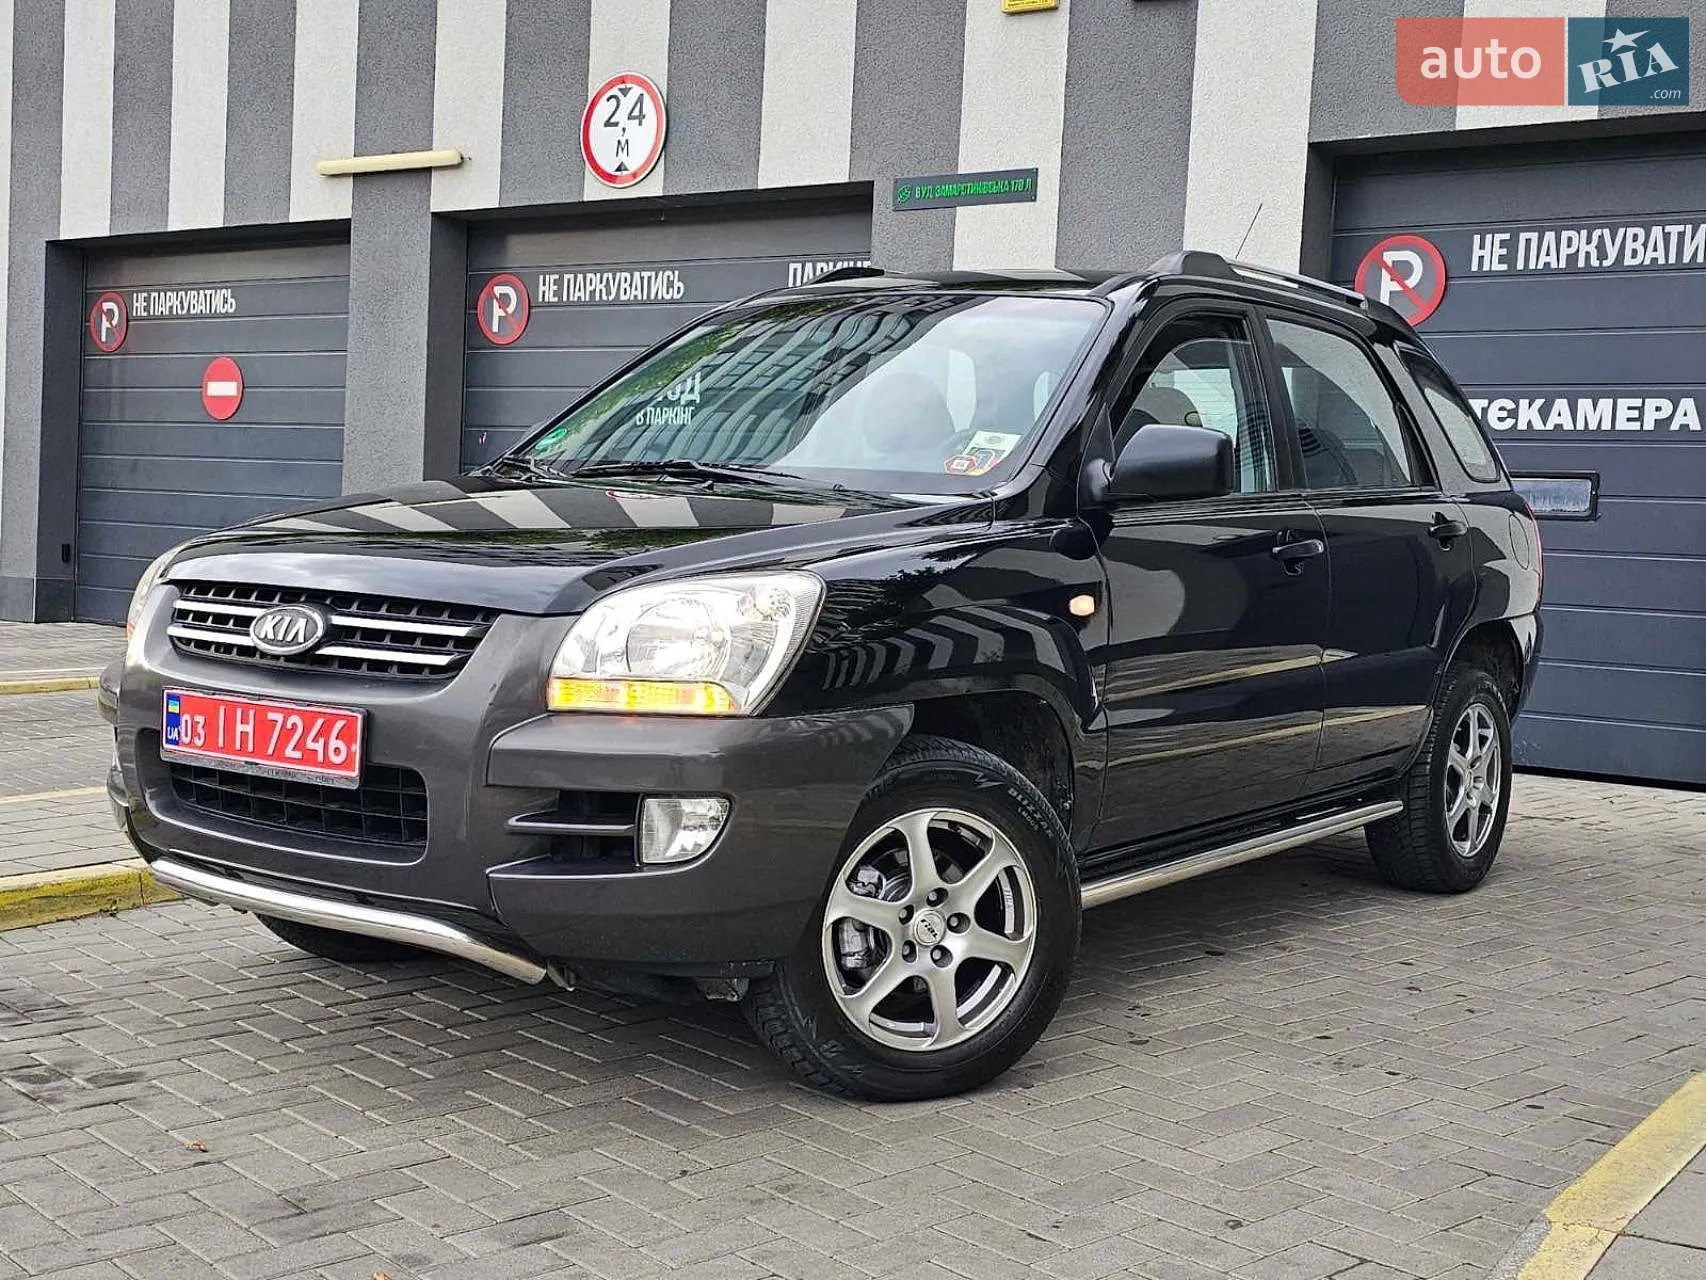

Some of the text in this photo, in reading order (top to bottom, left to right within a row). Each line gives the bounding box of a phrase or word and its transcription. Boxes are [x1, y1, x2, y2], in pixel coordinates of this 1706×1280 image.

[1471, 233, 1511, 272] НЕ
[539, 270, 685, 302] НЕ ПАРКУВАТИСЬ
[133, 288, 236, 317] НЕ ПАРКУВАТИСЬ
[646, 406, 695, 425] ПАРКІНГ
[259, 614, 308, 643] KIA
[166, 726, 180, 741] UA
[181, 713, 206, 748] 03
[266, 711, 349, 765] 7246
